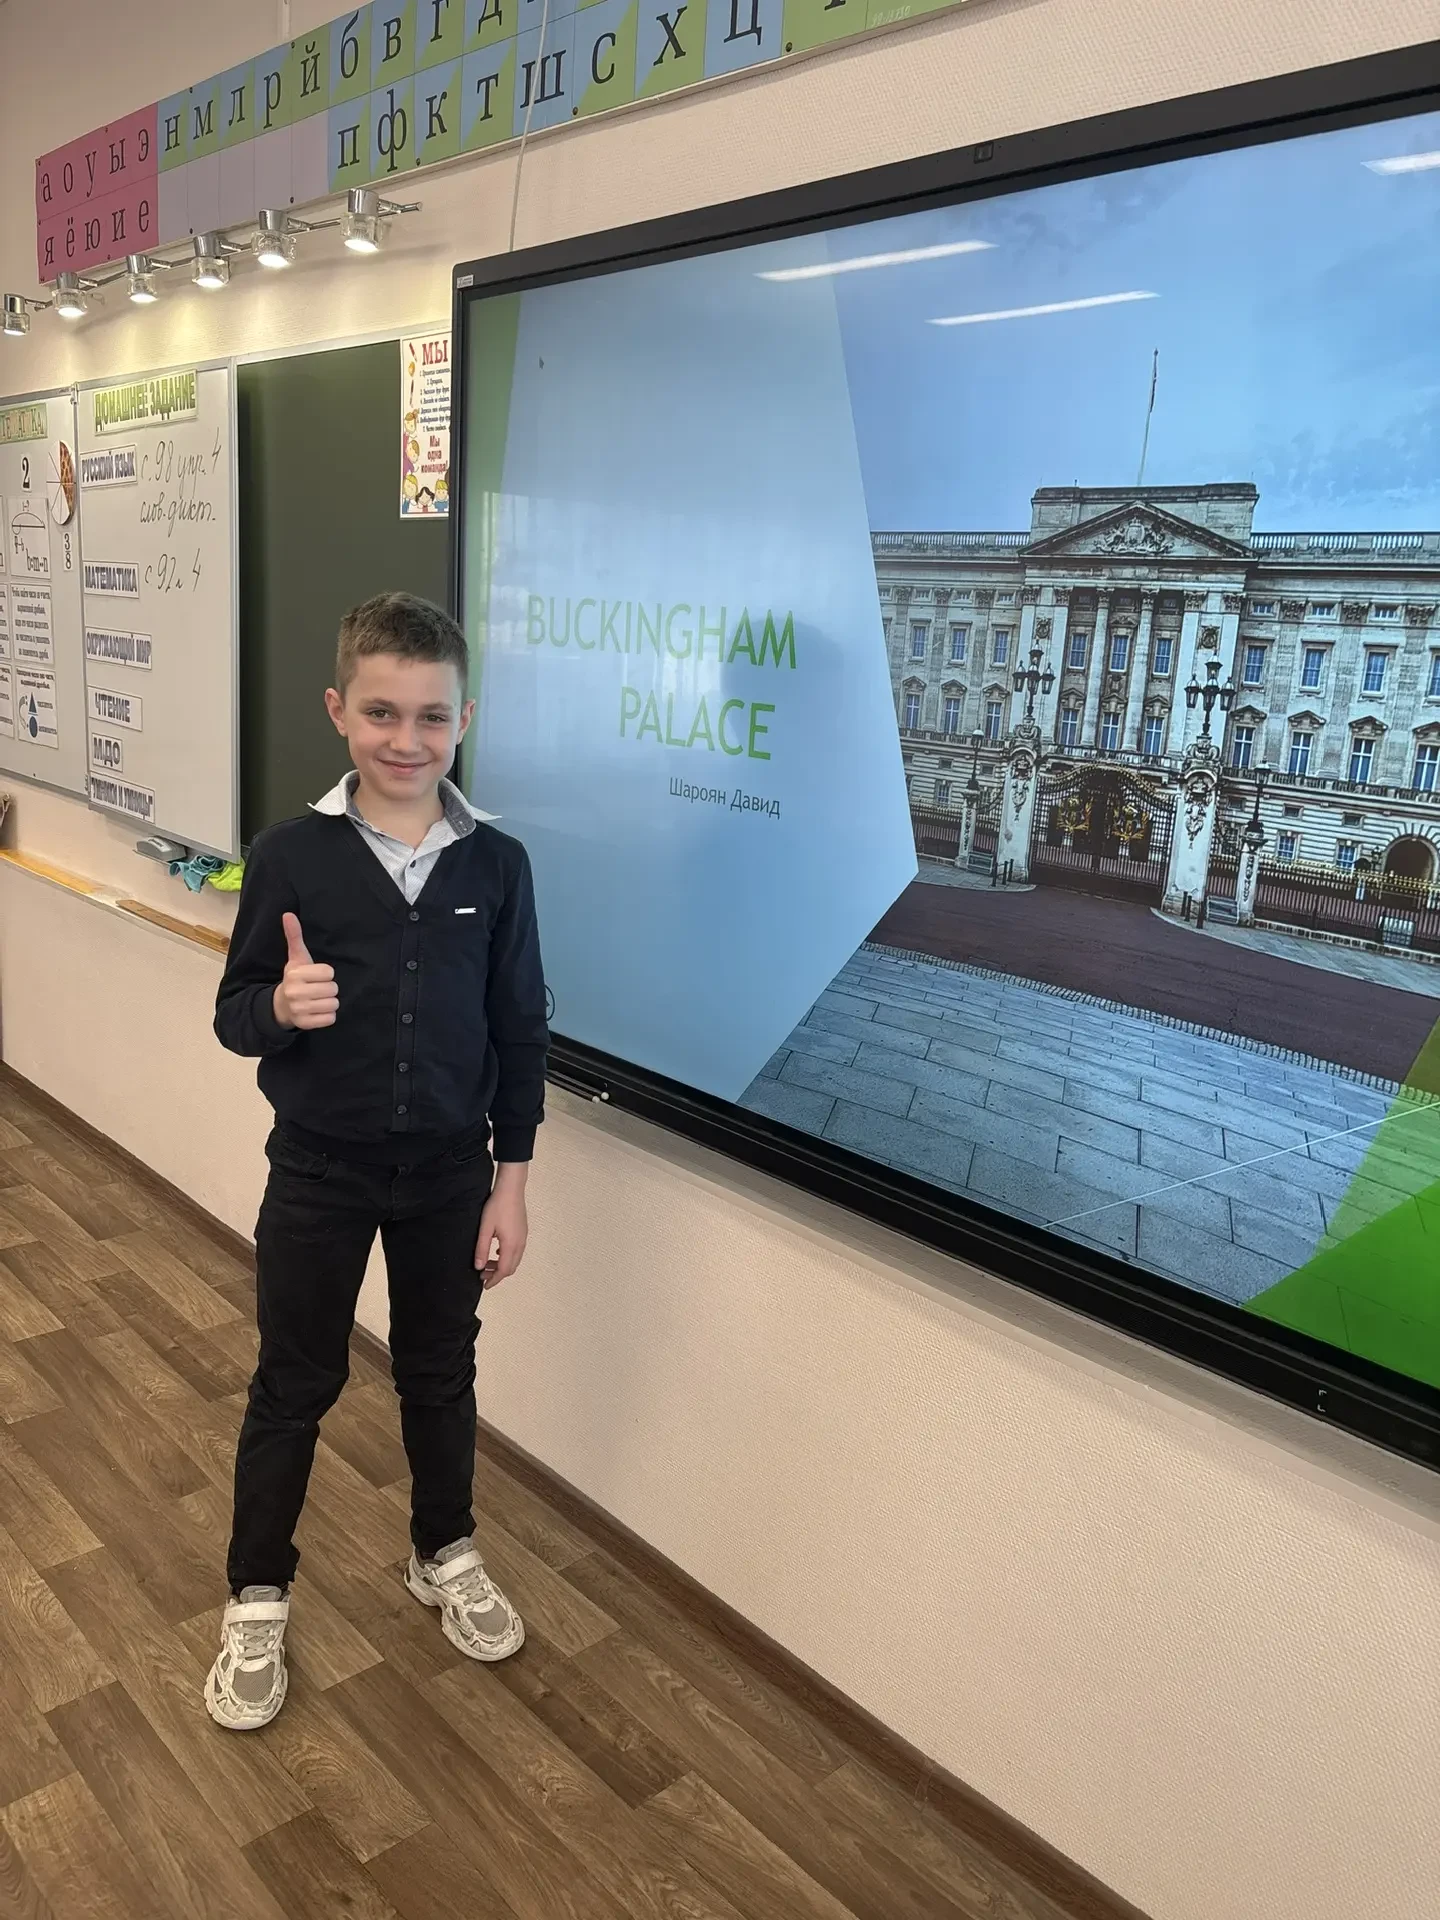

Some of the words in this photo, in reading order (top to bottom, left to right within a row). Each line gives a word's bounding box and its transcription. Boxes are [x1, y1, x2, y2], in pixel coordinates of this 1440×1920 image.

[41, 172, 53, 203] а
[63, 162, 74, 193] о
[85, 151, 97, 198] у
[109, 139, 127, 175] ы
[138, 128, 150, 162] э
[164, 114, 181, 151] н
[193, 100, 214, 139] м
[228, 85, 246, 126] л
[263, 71, 281, 129] р
[300, 41, 321, 98] й
[340, 10, 359, 79] б
[382, 17, 401, 62] в
[44, 236, 55, 266] я
[66, 216, 75, 257] ё
[84, 218, 101, 251] ю
[111, 208, 126, 243] и
[138, 199, 150, 233] е
[338, 124, 360, 169] п
[377, 88, 407, 172] ф
[425, 91, 447, 140] к
[476, 73, 499, 121] т
[521, 49, 567, 108] ш
[422, 340, 448, 365] МЫ
[95, 383, 149, 432] ДОМАШНЕЕ
[150, 372, 196, 421] ЗАДАНИЕ
[22, 456, 30, 489] 2
[81, 451, 113, 482] РУССКИЙ
[114, 451, 136, 478] ЯЗЫК
[84, 565, 138, 592] МАТЕМАТИКА
[526, 594, 797, 669] BUCKINGHAM
[94, 692, 131, 723] ЧТЕНИЕ
[619, 686, 776, 761] PALACE
[93, 737, 121, 768] МДО
[669, 776, 727, 804] Шароян
[730, 789, 781, 819] Давид
